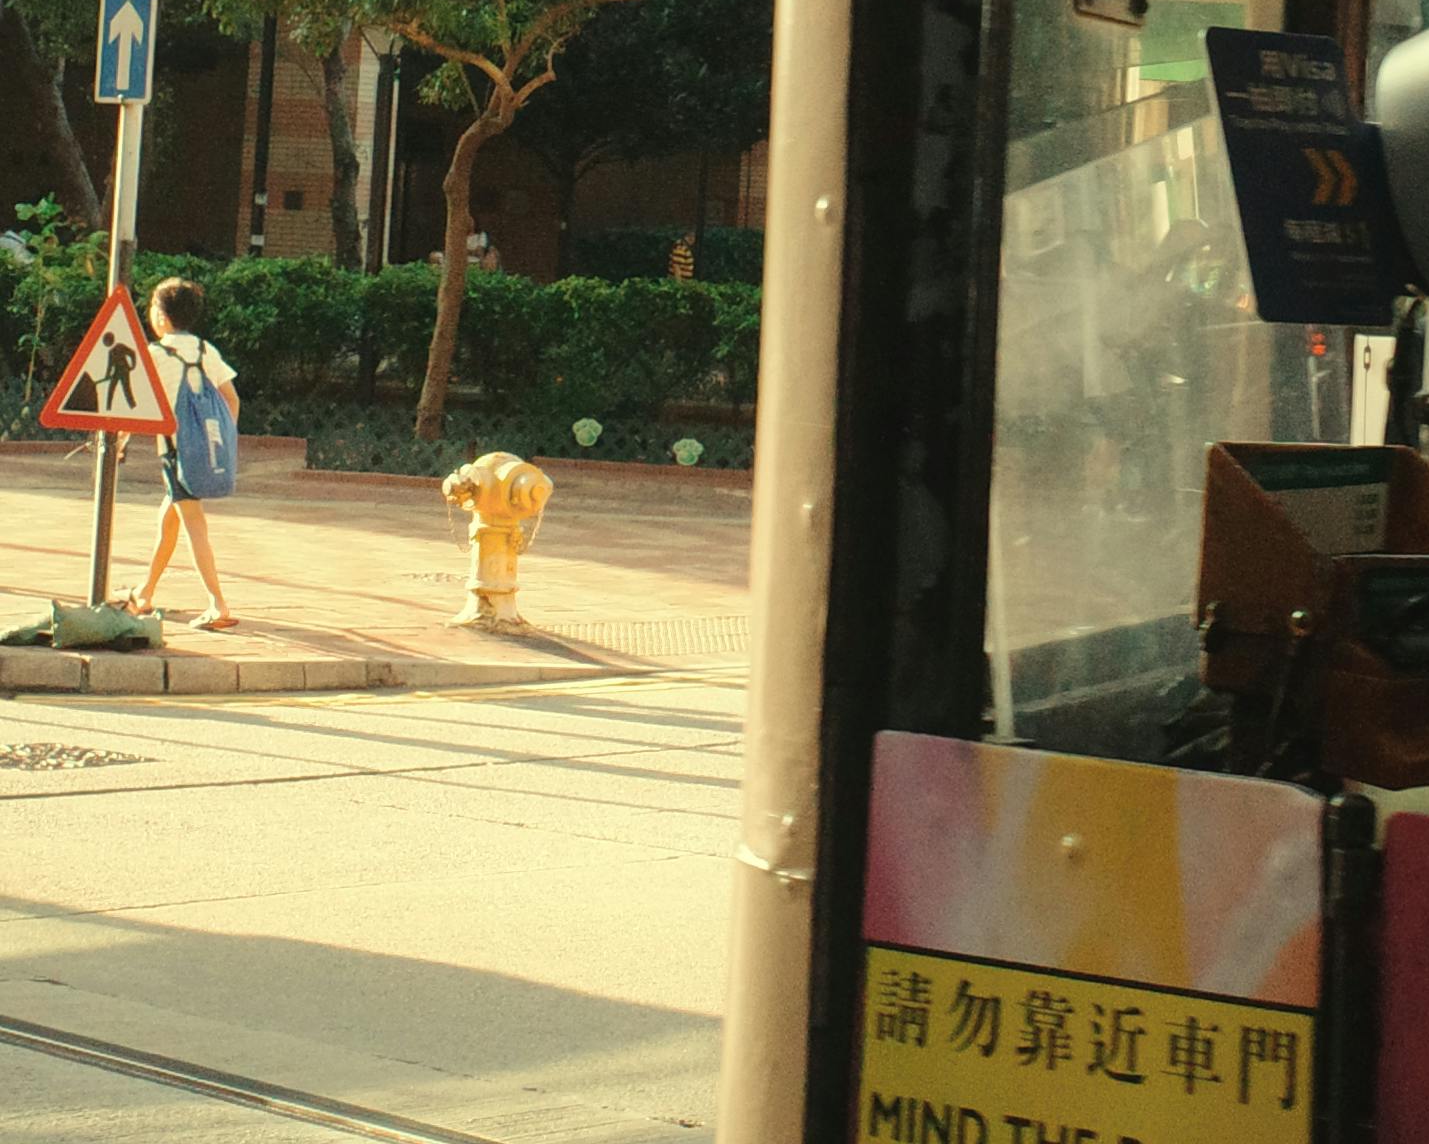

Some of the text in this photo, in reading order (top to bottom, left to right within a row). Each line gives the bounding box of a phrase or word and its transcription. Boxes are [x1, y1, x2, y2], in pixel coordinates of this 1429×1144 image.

[875, 970, 1299, 1110] 請勿靠近車門
[870, 1092, 988, 1144] MIND
